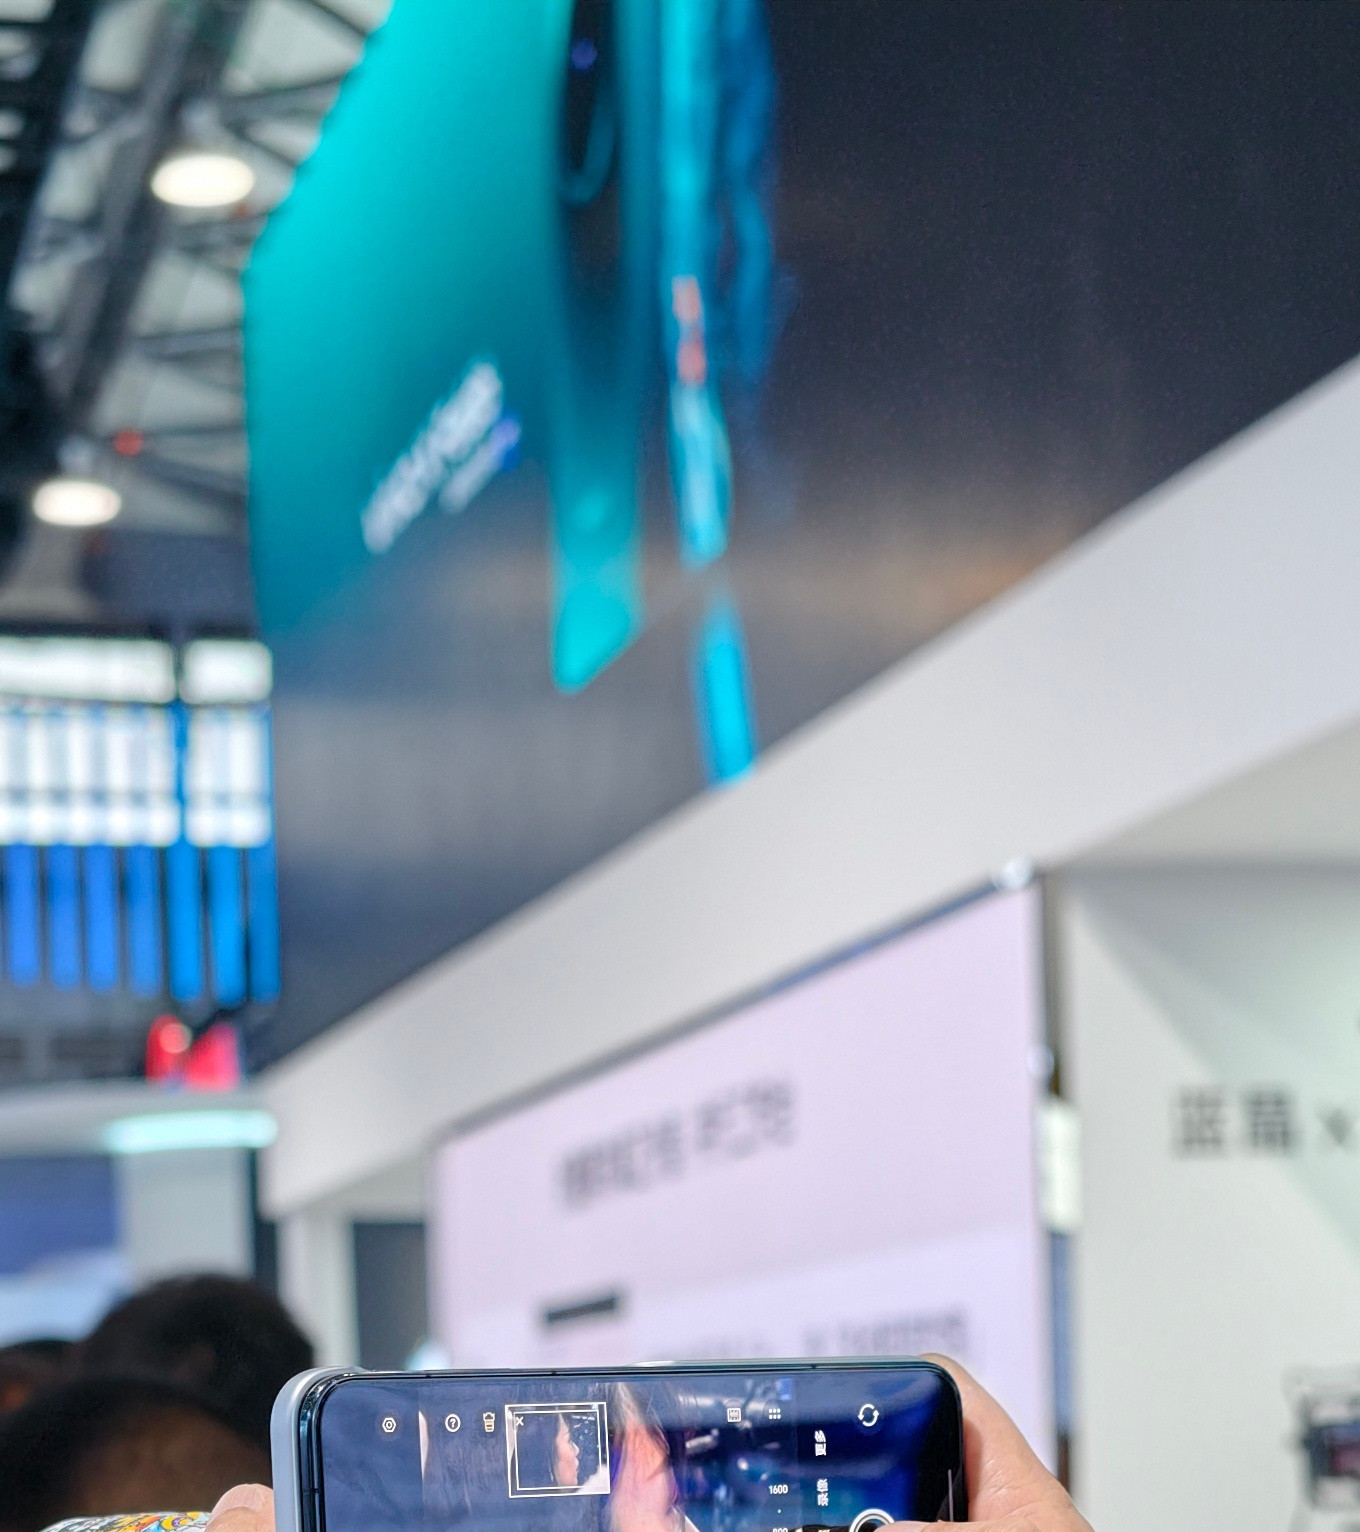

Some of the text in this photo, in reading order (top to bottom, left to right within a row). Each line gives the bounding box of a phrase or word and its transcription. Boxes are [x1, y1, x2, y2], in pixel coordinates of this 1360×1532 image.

[814, 1430, 827, 1457] 更多
[768, 1484, 789, 1495] 1600
[817, 1478, 829, 1507] 录像
